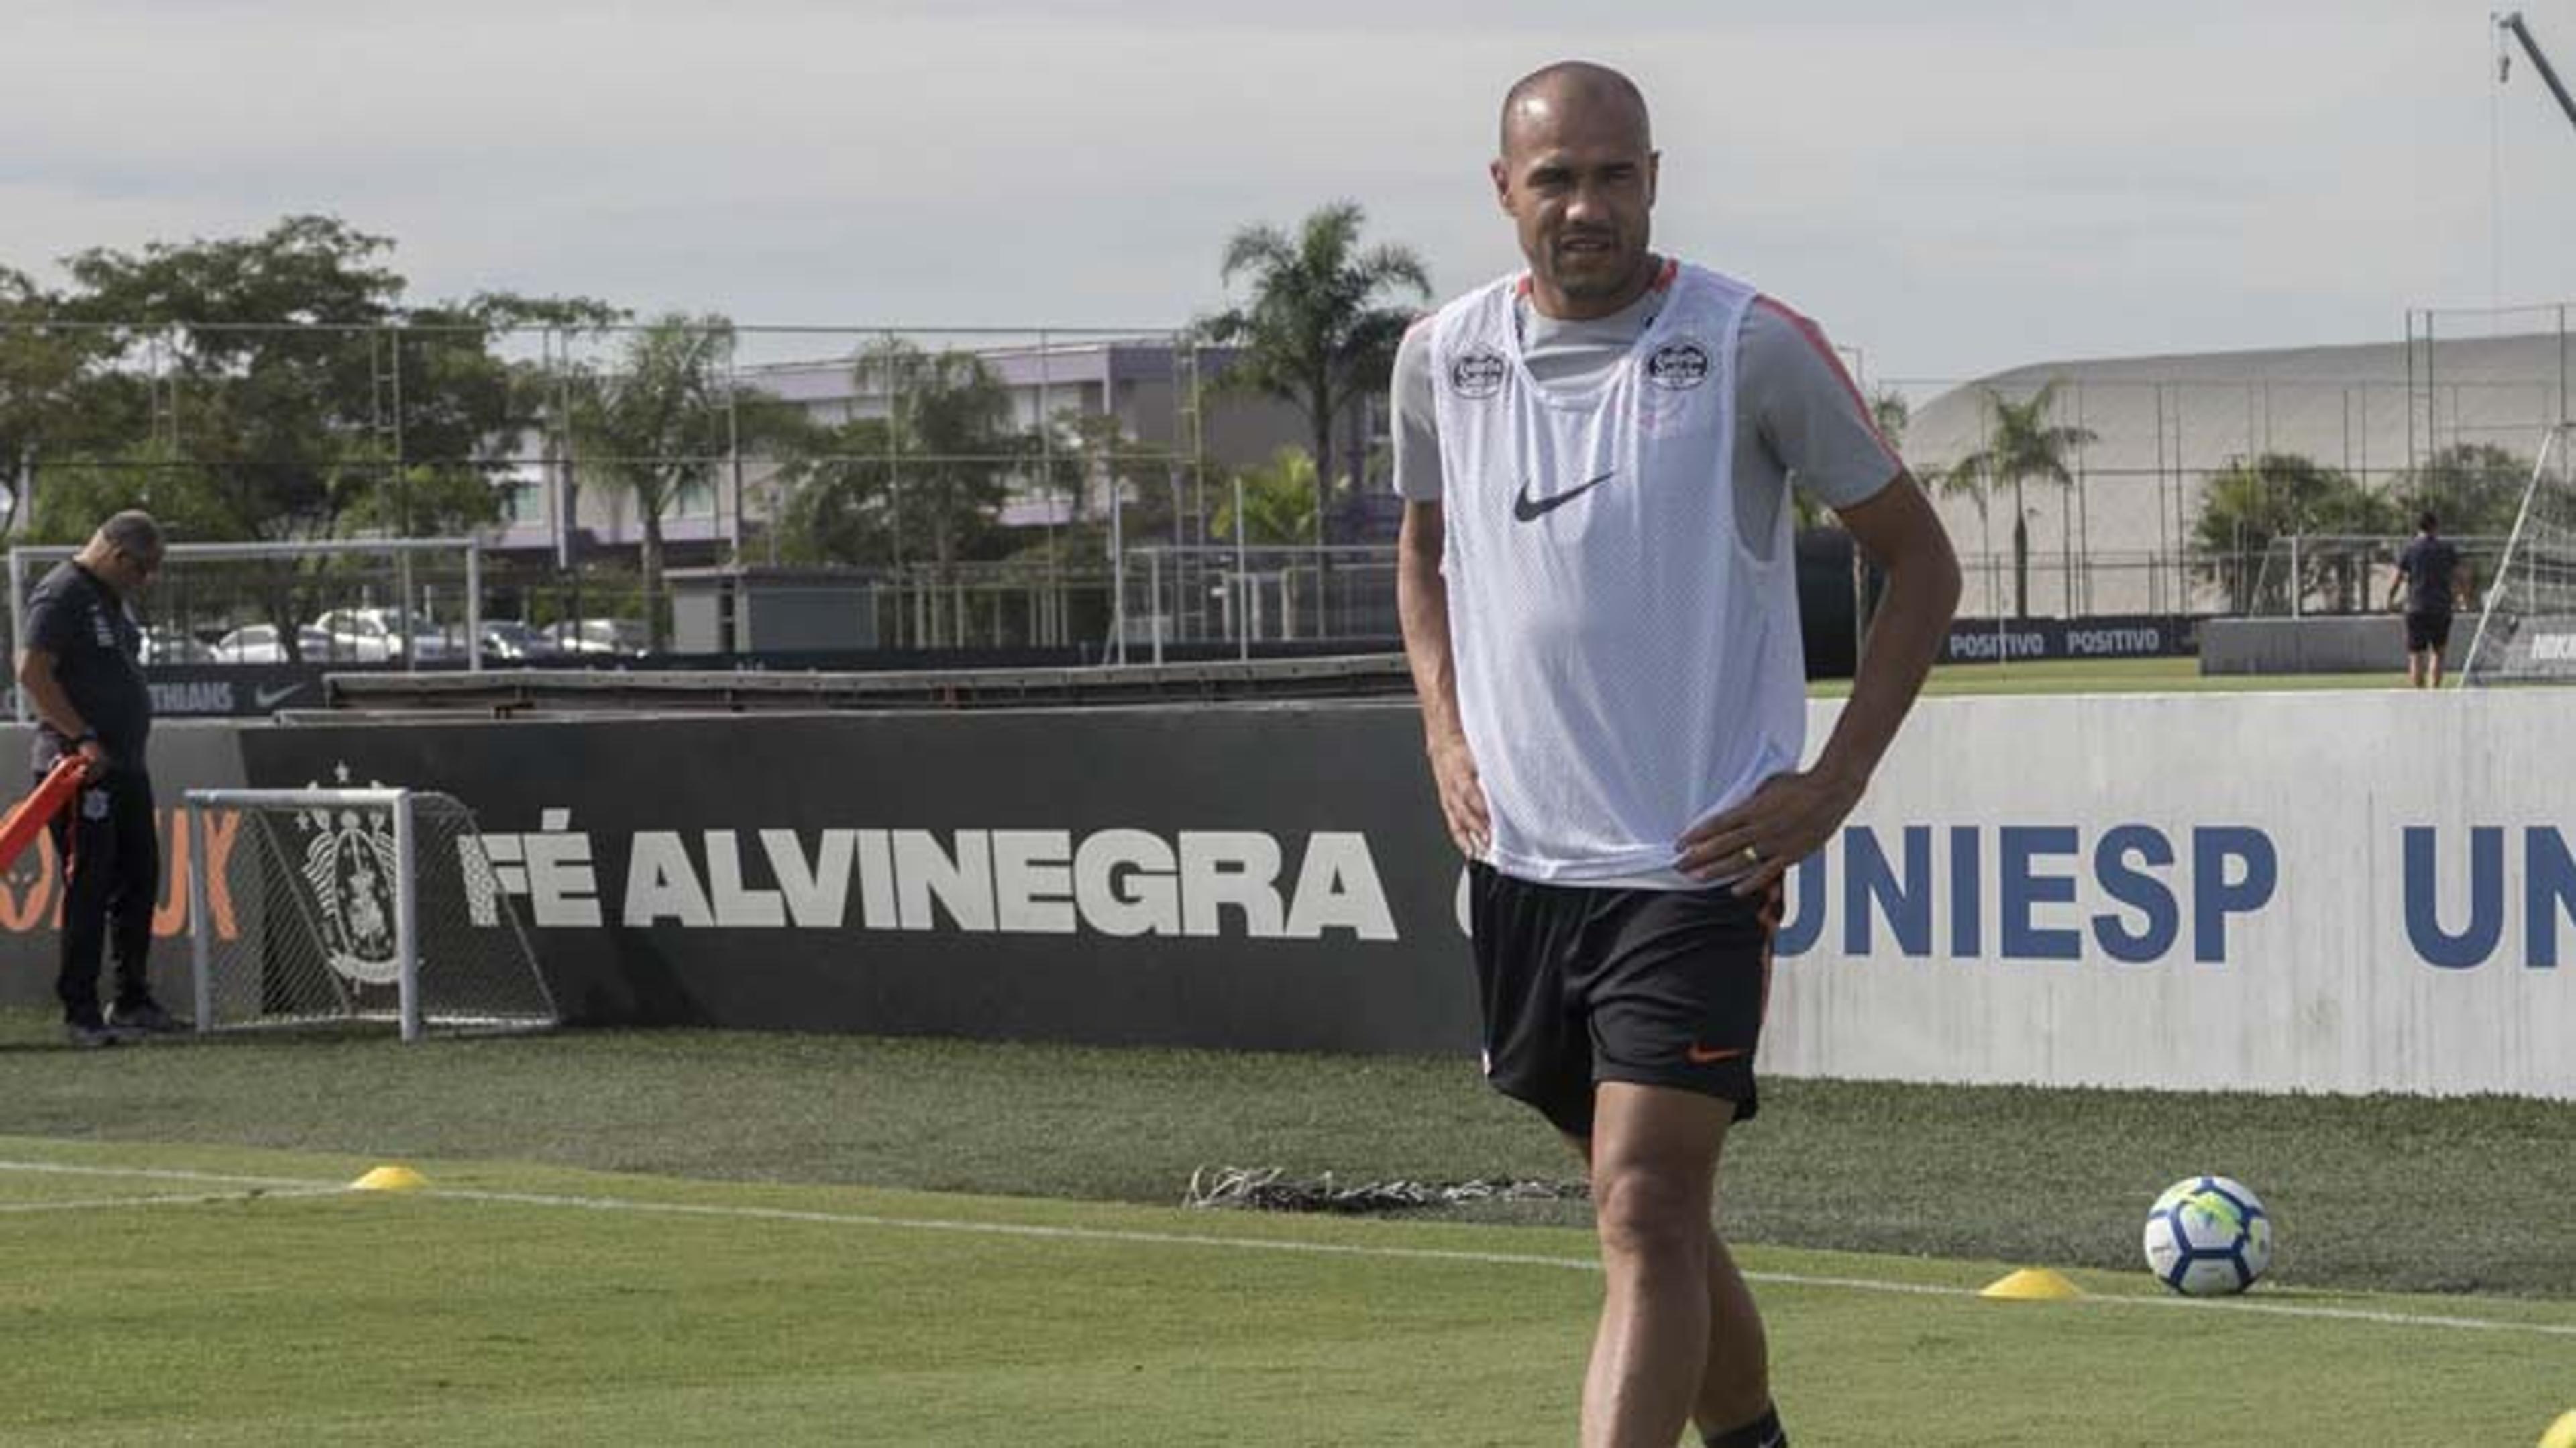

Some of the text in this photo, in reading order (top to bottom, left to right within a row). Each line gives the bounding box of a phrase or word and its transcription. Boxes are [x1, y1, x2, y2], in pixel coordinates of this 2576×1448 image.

[1950, 628, 2160, 658] POSITIVO POSITIVO
[457, 807, 603, 927] FÉ
[622, 828, 1399, 941] ALVINEGRA
